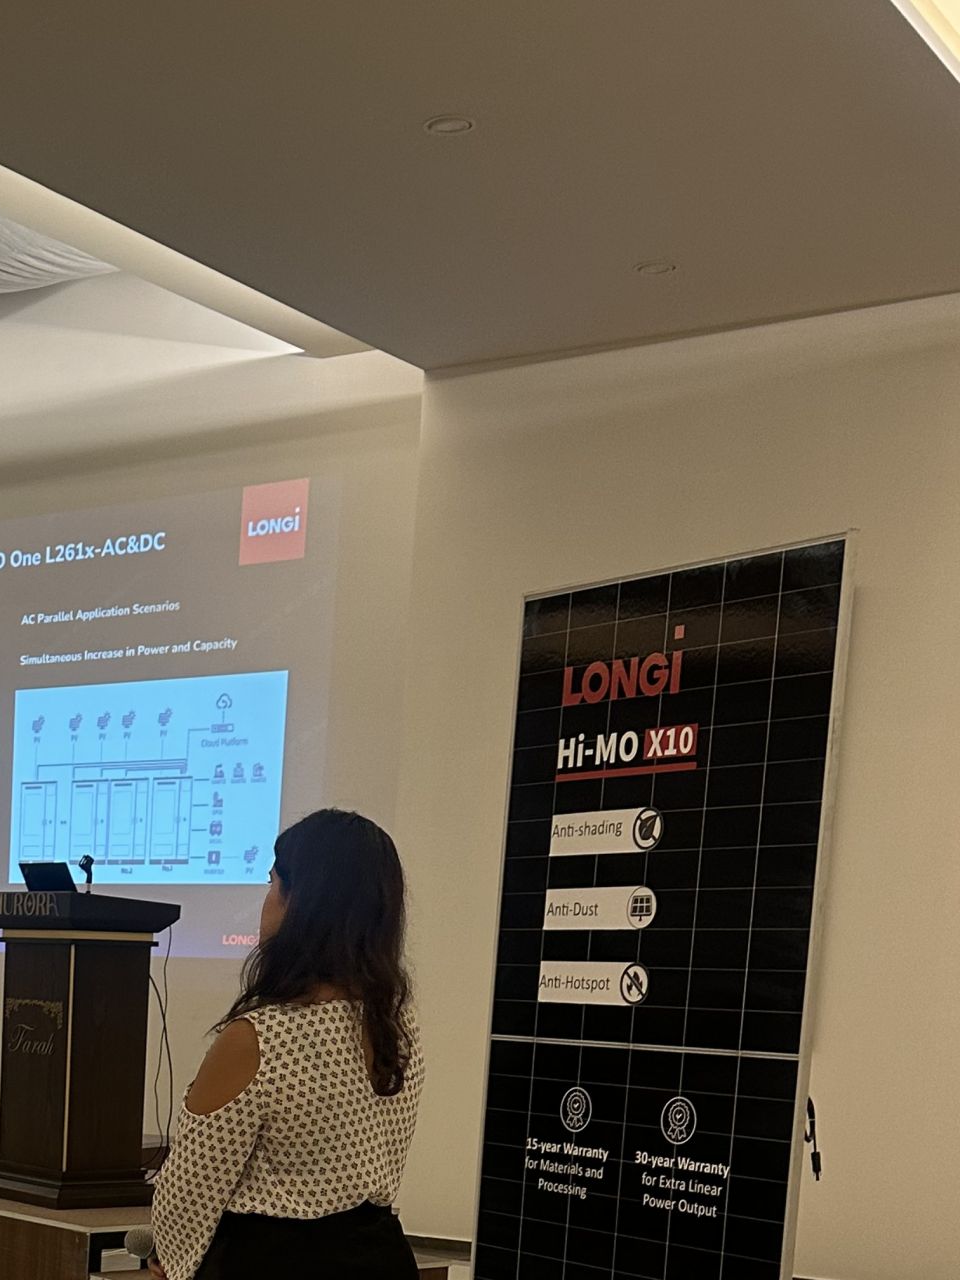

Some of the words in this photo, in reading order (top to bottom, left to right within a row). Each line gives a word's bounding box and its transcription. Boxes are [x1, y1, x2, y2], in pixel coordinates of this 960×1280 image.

[247, 507, 301, 537] LONGi
[10, 549, 41, 569] One
[45, 532, 166, 564] L261x-AC&DC
[21, 615, 36, 626] AC
[37, 610, 74, 624] Parallel
[76, 605, 130, 621] Application
[132, 601, 181, 615] Scenarios
[19, 653, 82, 666] Simultaneous
[84, 649, 124, 661] Increase
[126, 646, 135, 657] in
[137, 643, 170, 656] Power
[172, 641, 191, 653] and
[193, 637, 238, 652] Capacity
[562, 624, 686, 707] LONGi
[556, 730, 640, 770] Hi-MO
[646, 726, 694, 758] X10
[552, 820, 623, 838] Anti-shading
[546, 902, 599, 917] Anti-Dust
[539, 974, 611, 993] Anti-Hotspot
[525, 1138, 562, 1154] 15-year
[563, 1142, 610, 1163] Warranty
[524, 1156, 539, 1170] for
[540, 1159, 584, 1178] Materials
[585, 1166, 604, 1180] and
[635, 1151, 676, 1169] 30-year
[677, 1156, 731, 1179] Warranty
[538, 1178, 588, 1200] Processing
[641, 1172, 657, 1187] for
[659, 1175, 687, 1191] Extra
[688, 1179, 724, 1197] Linear
[643, 1193, 677, 1211] Power
[678, 1199, 719, 1219] Output
